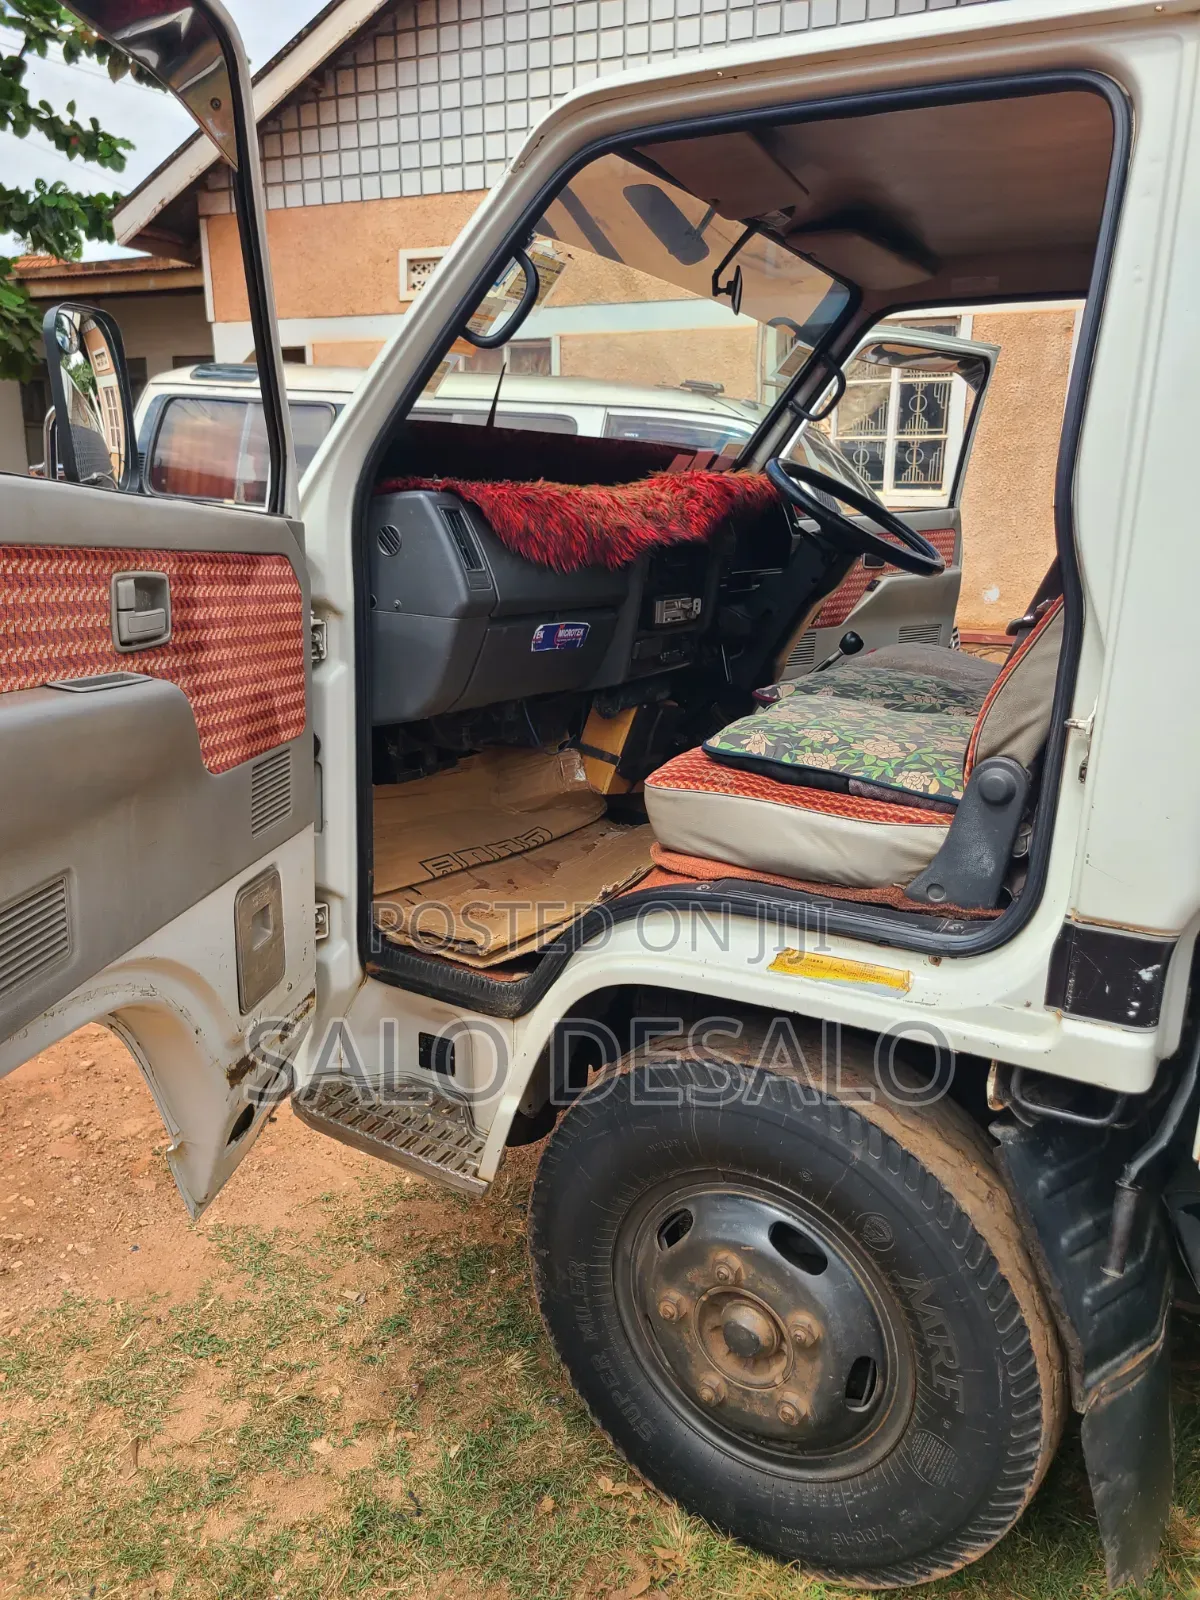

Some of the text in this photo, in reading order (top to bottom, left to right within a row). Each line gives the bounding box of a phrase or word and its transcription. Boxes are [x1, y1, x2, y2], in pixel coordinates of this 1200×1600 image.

[567, 1260, 656, 1442] SUPER MILER
[891, 1270, 965, 1414] MRF
